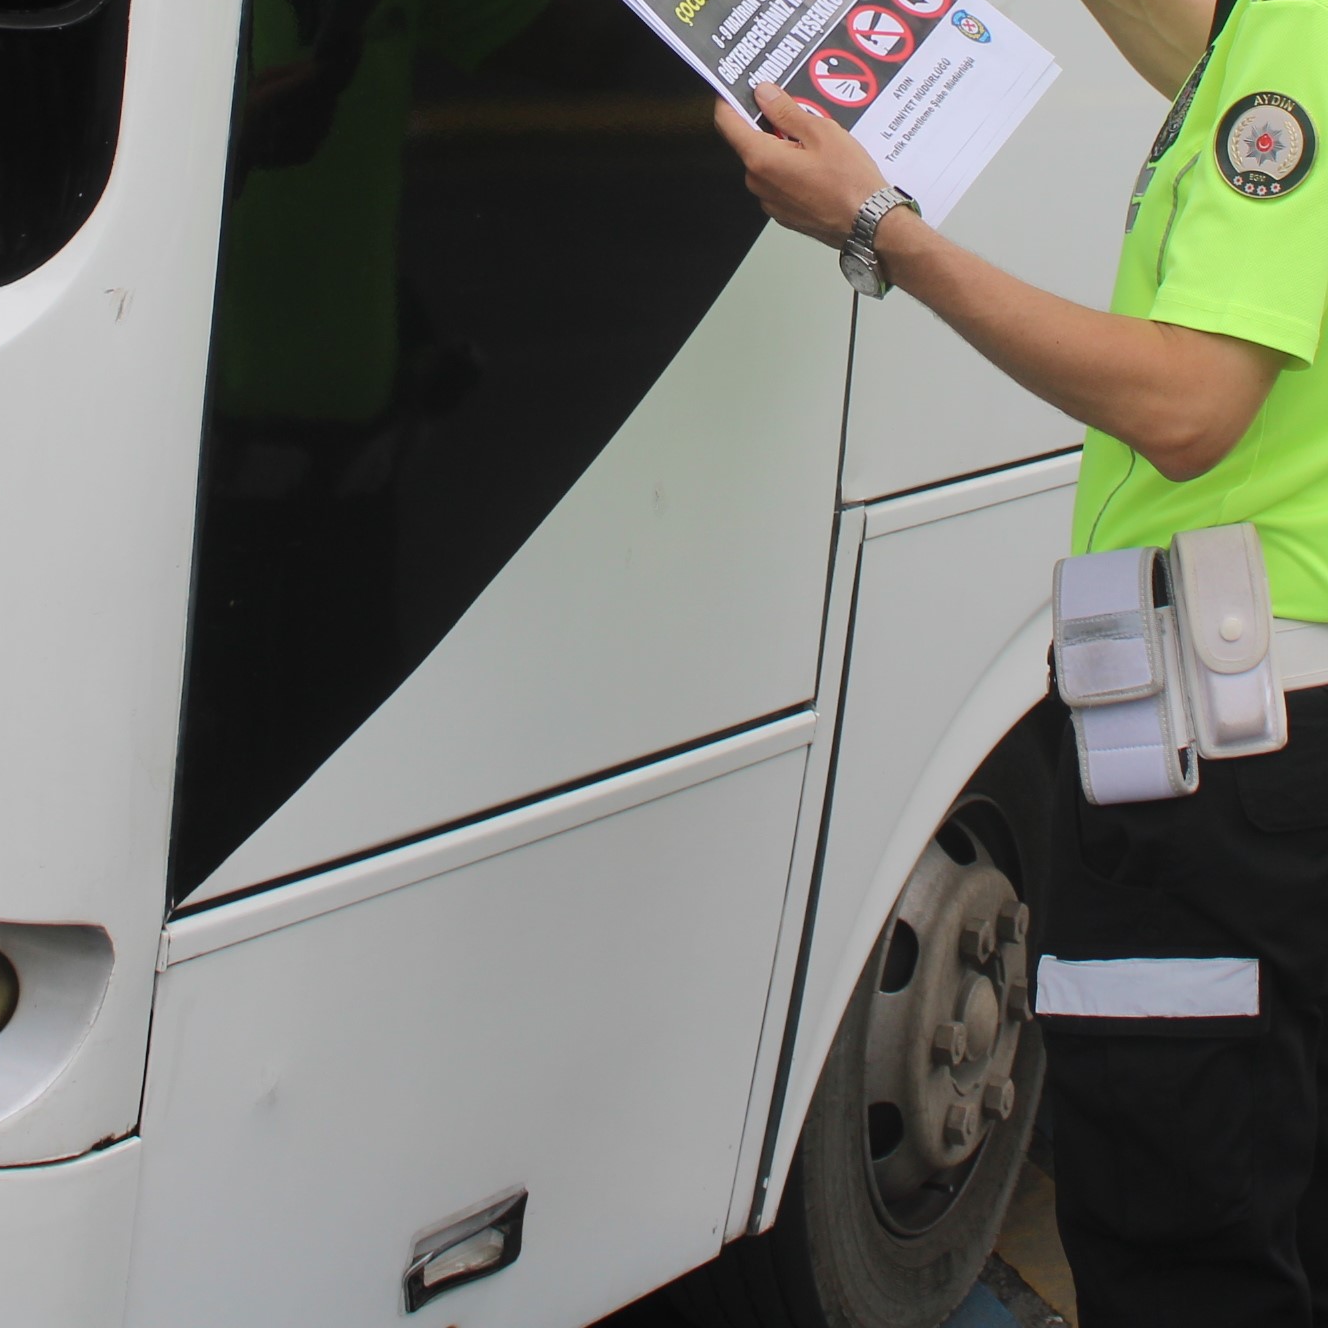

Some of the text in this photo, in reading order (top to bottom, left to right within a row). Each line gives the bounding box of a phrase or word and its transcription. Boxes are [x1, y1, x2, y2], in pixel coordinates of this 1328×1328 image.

[880, 57, 952, 140] İL EMNİYET MÜDÜRLÜĞÜ
[885, 56, 976, 162] Trafik Denetleme Şube Müdürlüğü
[893, 75, 914, 100] AYDIN
